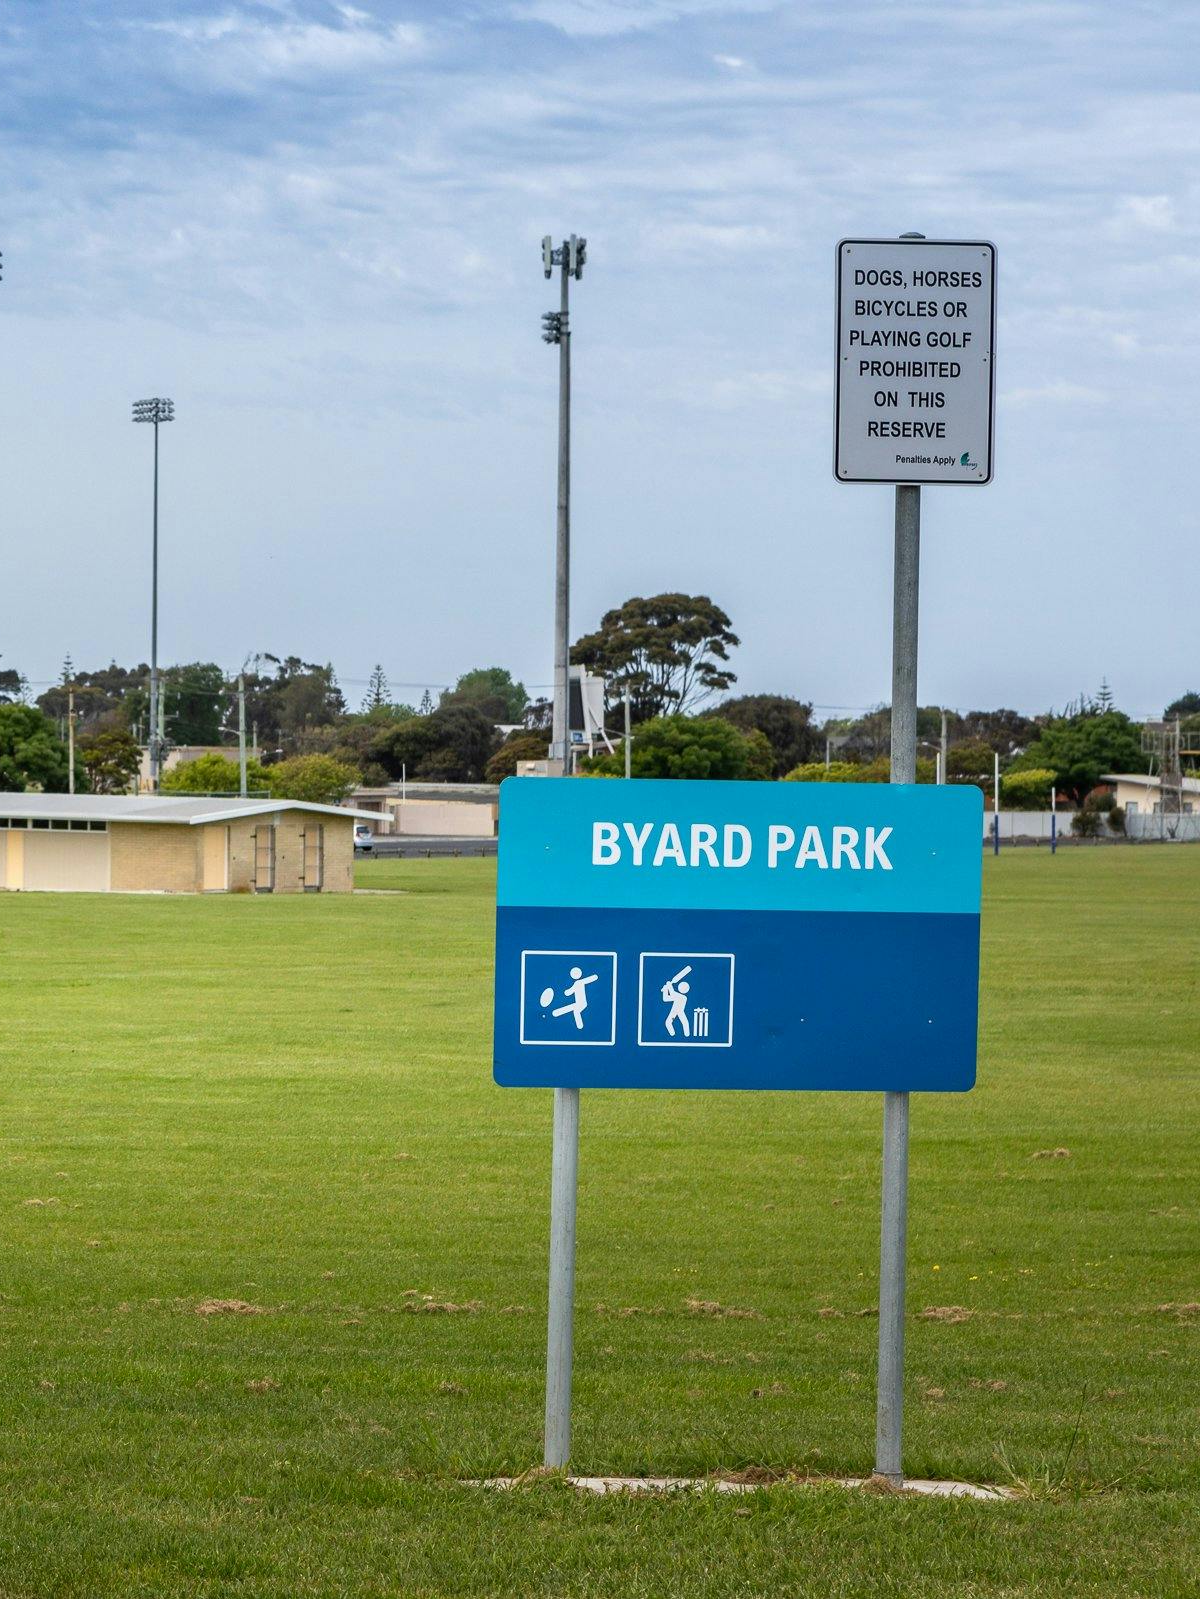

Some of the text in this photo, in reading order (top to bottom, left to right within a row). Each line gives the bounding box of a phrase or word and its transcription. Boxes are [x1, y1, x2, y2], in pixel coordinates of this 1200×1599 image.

[854, 269, 983, 289] DOGS, HORSES
[854, 300, 968, 318] BICYCLES OR
[849, 330, 972, 348] PLAYING GOLF
[859, 360, 961, 378] PROHIBITED
[873, 390, 945, 408] ON THIS
[867, 421, 946, 438] RESERVE
[895, 454, 932, 464] Penalties
[932, 455, 956, 467] Apply
[591, 821, 894, 871] BYARD PARK
